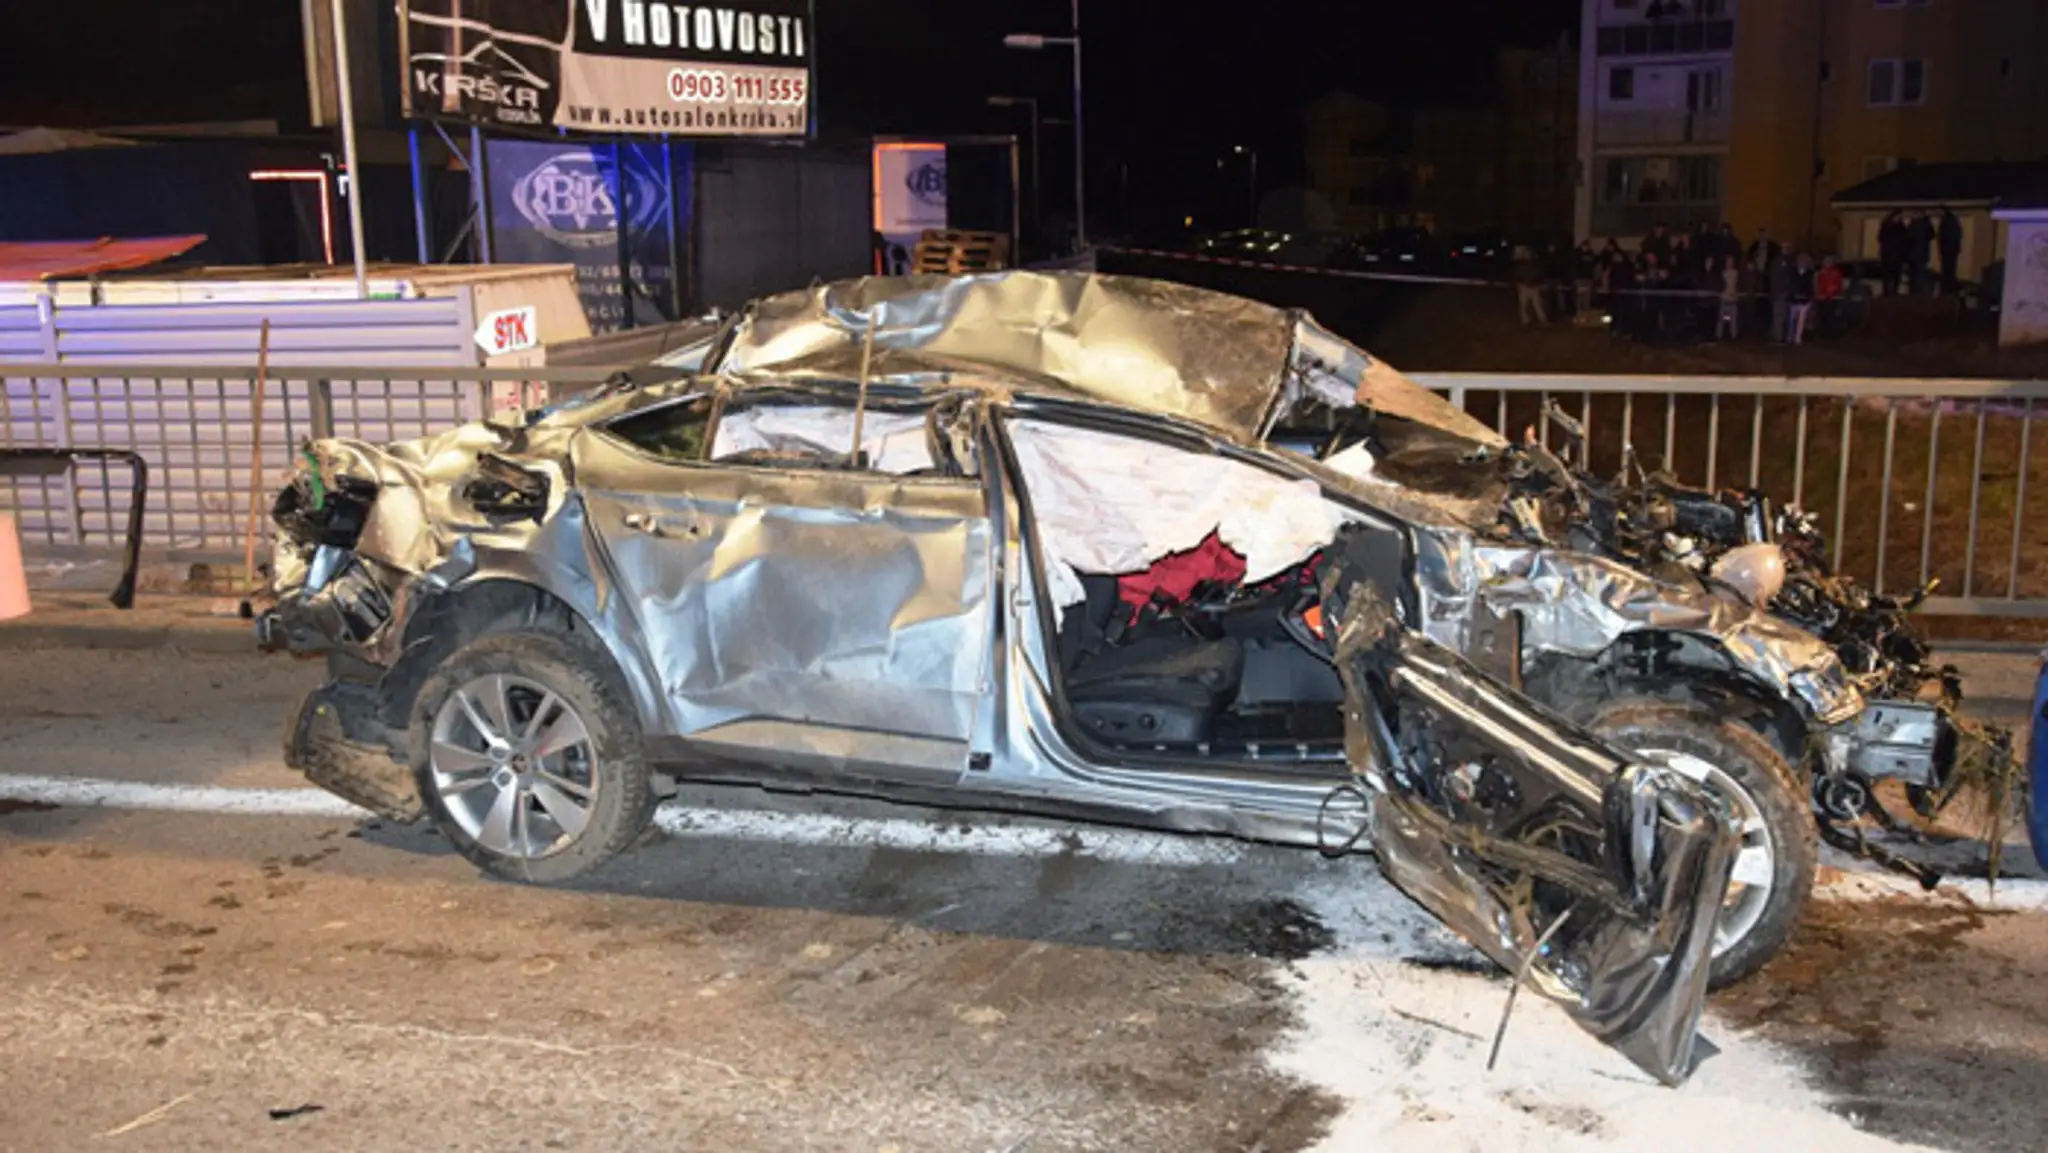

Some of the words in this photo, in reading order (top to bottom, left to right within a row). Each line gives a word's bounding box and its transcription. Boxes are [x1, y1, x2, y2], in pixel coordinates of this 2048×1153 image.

[585, 0, 608, 42] V
[622, 1, 804, 57] HOTOVOSTI
[671, 73, 726, 98] 0903
[734, 76, 763, 100] 111
[768, 78, 804, 101] 555
[494, 312, 528, 349] STK
